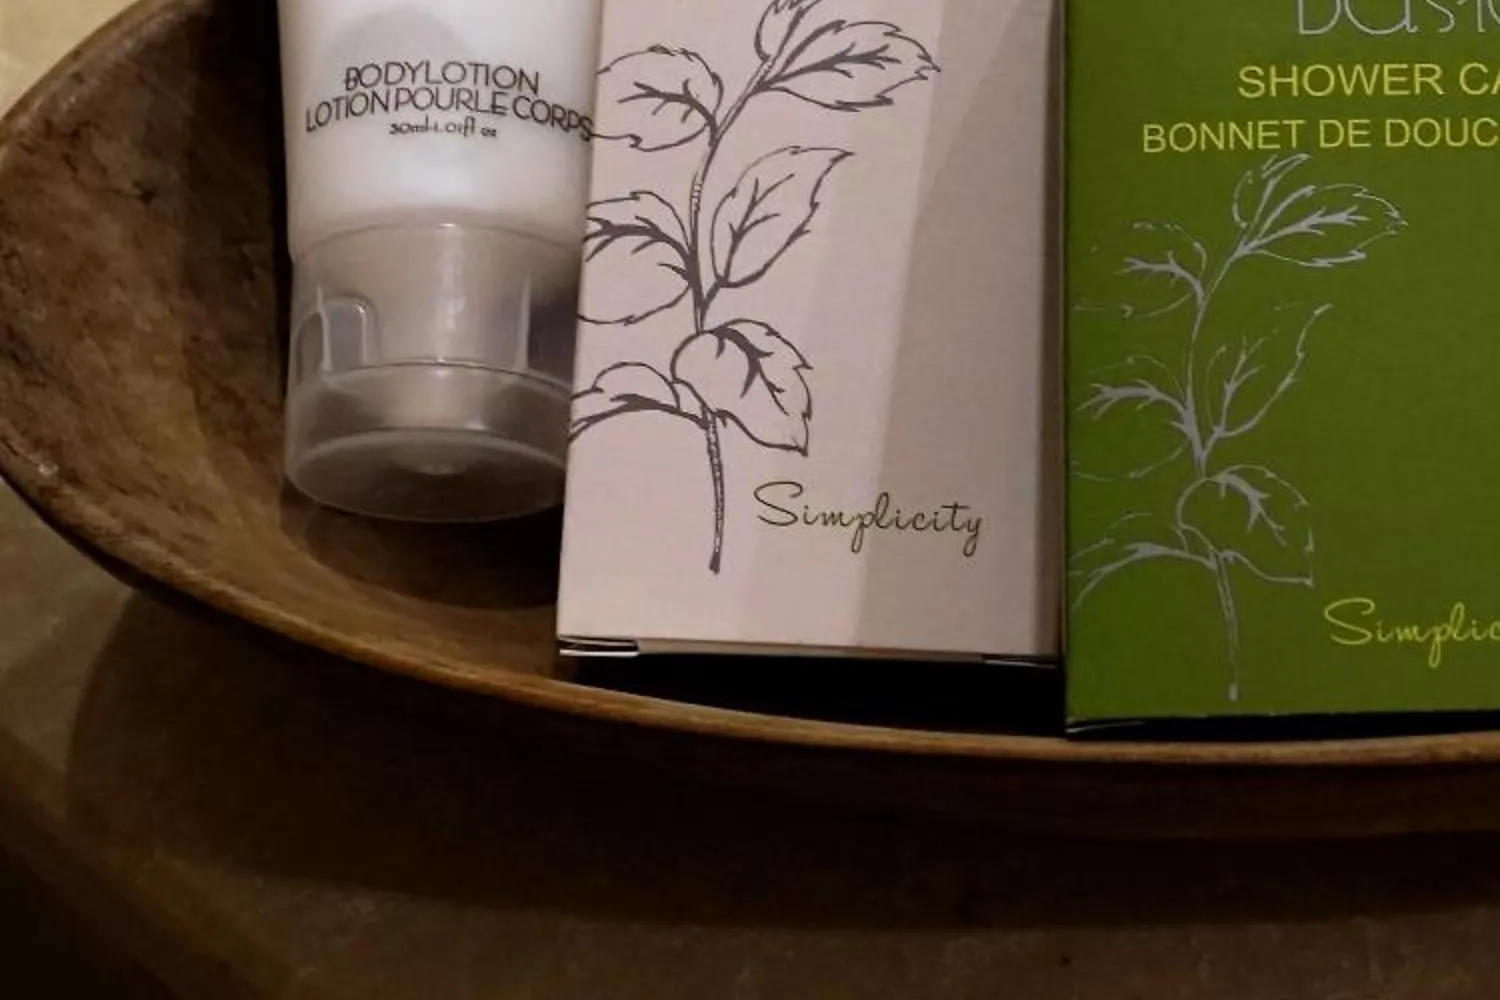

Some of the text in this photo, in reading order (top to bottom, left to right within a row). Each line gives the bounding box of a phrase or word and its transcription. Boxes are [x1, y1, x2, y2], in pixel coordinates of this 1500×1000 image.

[1238, 63, 1445, 99] SHOWER
[305, 87, 390, 133] LOTION
[511, 94, 595, 143] CORPS
[1142, 119, 1306, 153] BONNET
[1318, 118, 1372, 149] DE
[753, 480, 983, 558] Simplicity
